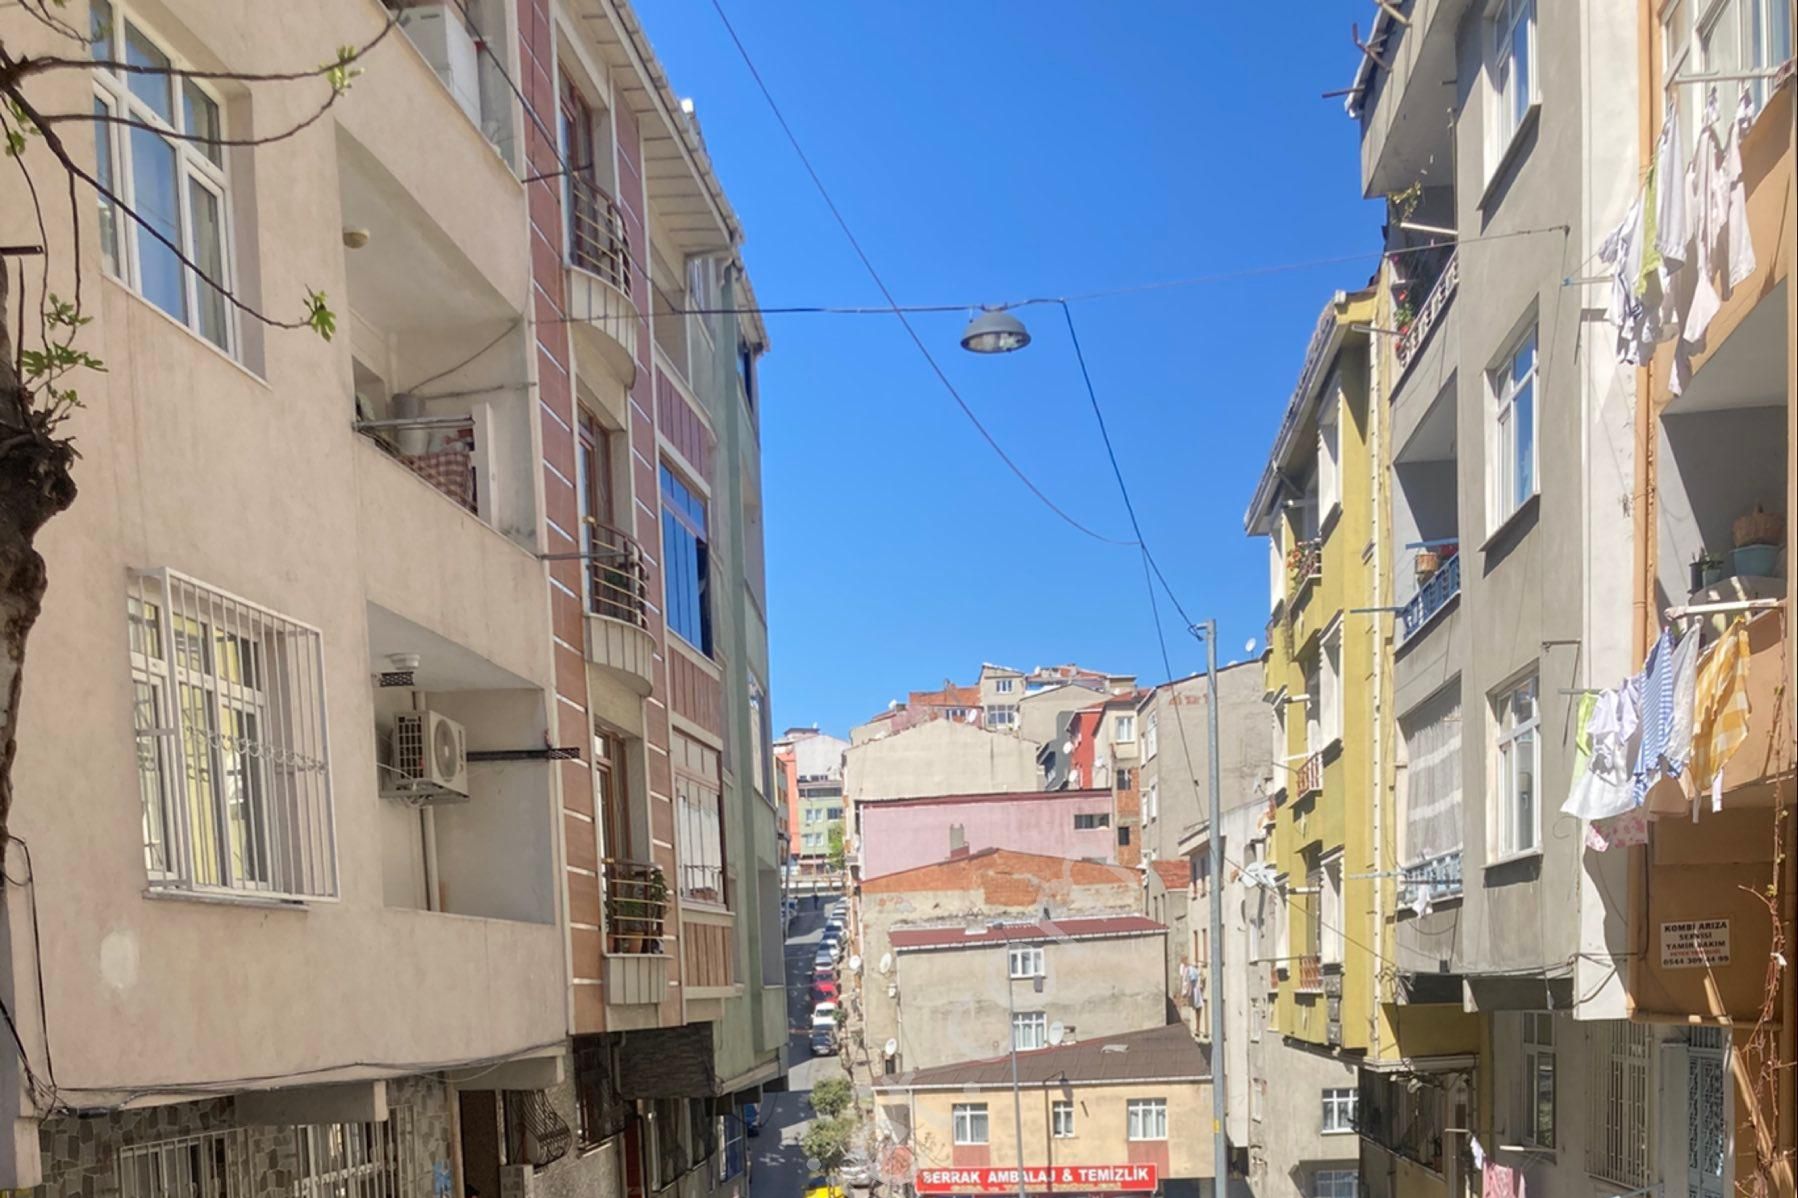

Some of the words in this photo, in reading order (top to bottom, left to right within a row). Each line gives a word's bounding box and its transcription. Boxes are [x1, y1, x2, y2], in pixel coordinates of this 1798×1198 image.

[1698, 921, 1727, 930] ARIZA
[988, 1169, 1056, 1183] AMBALAJ
[1062, 1168, 1073, 1182] &
[1078, 1165, 1149, 1182] TEMİZLİK
